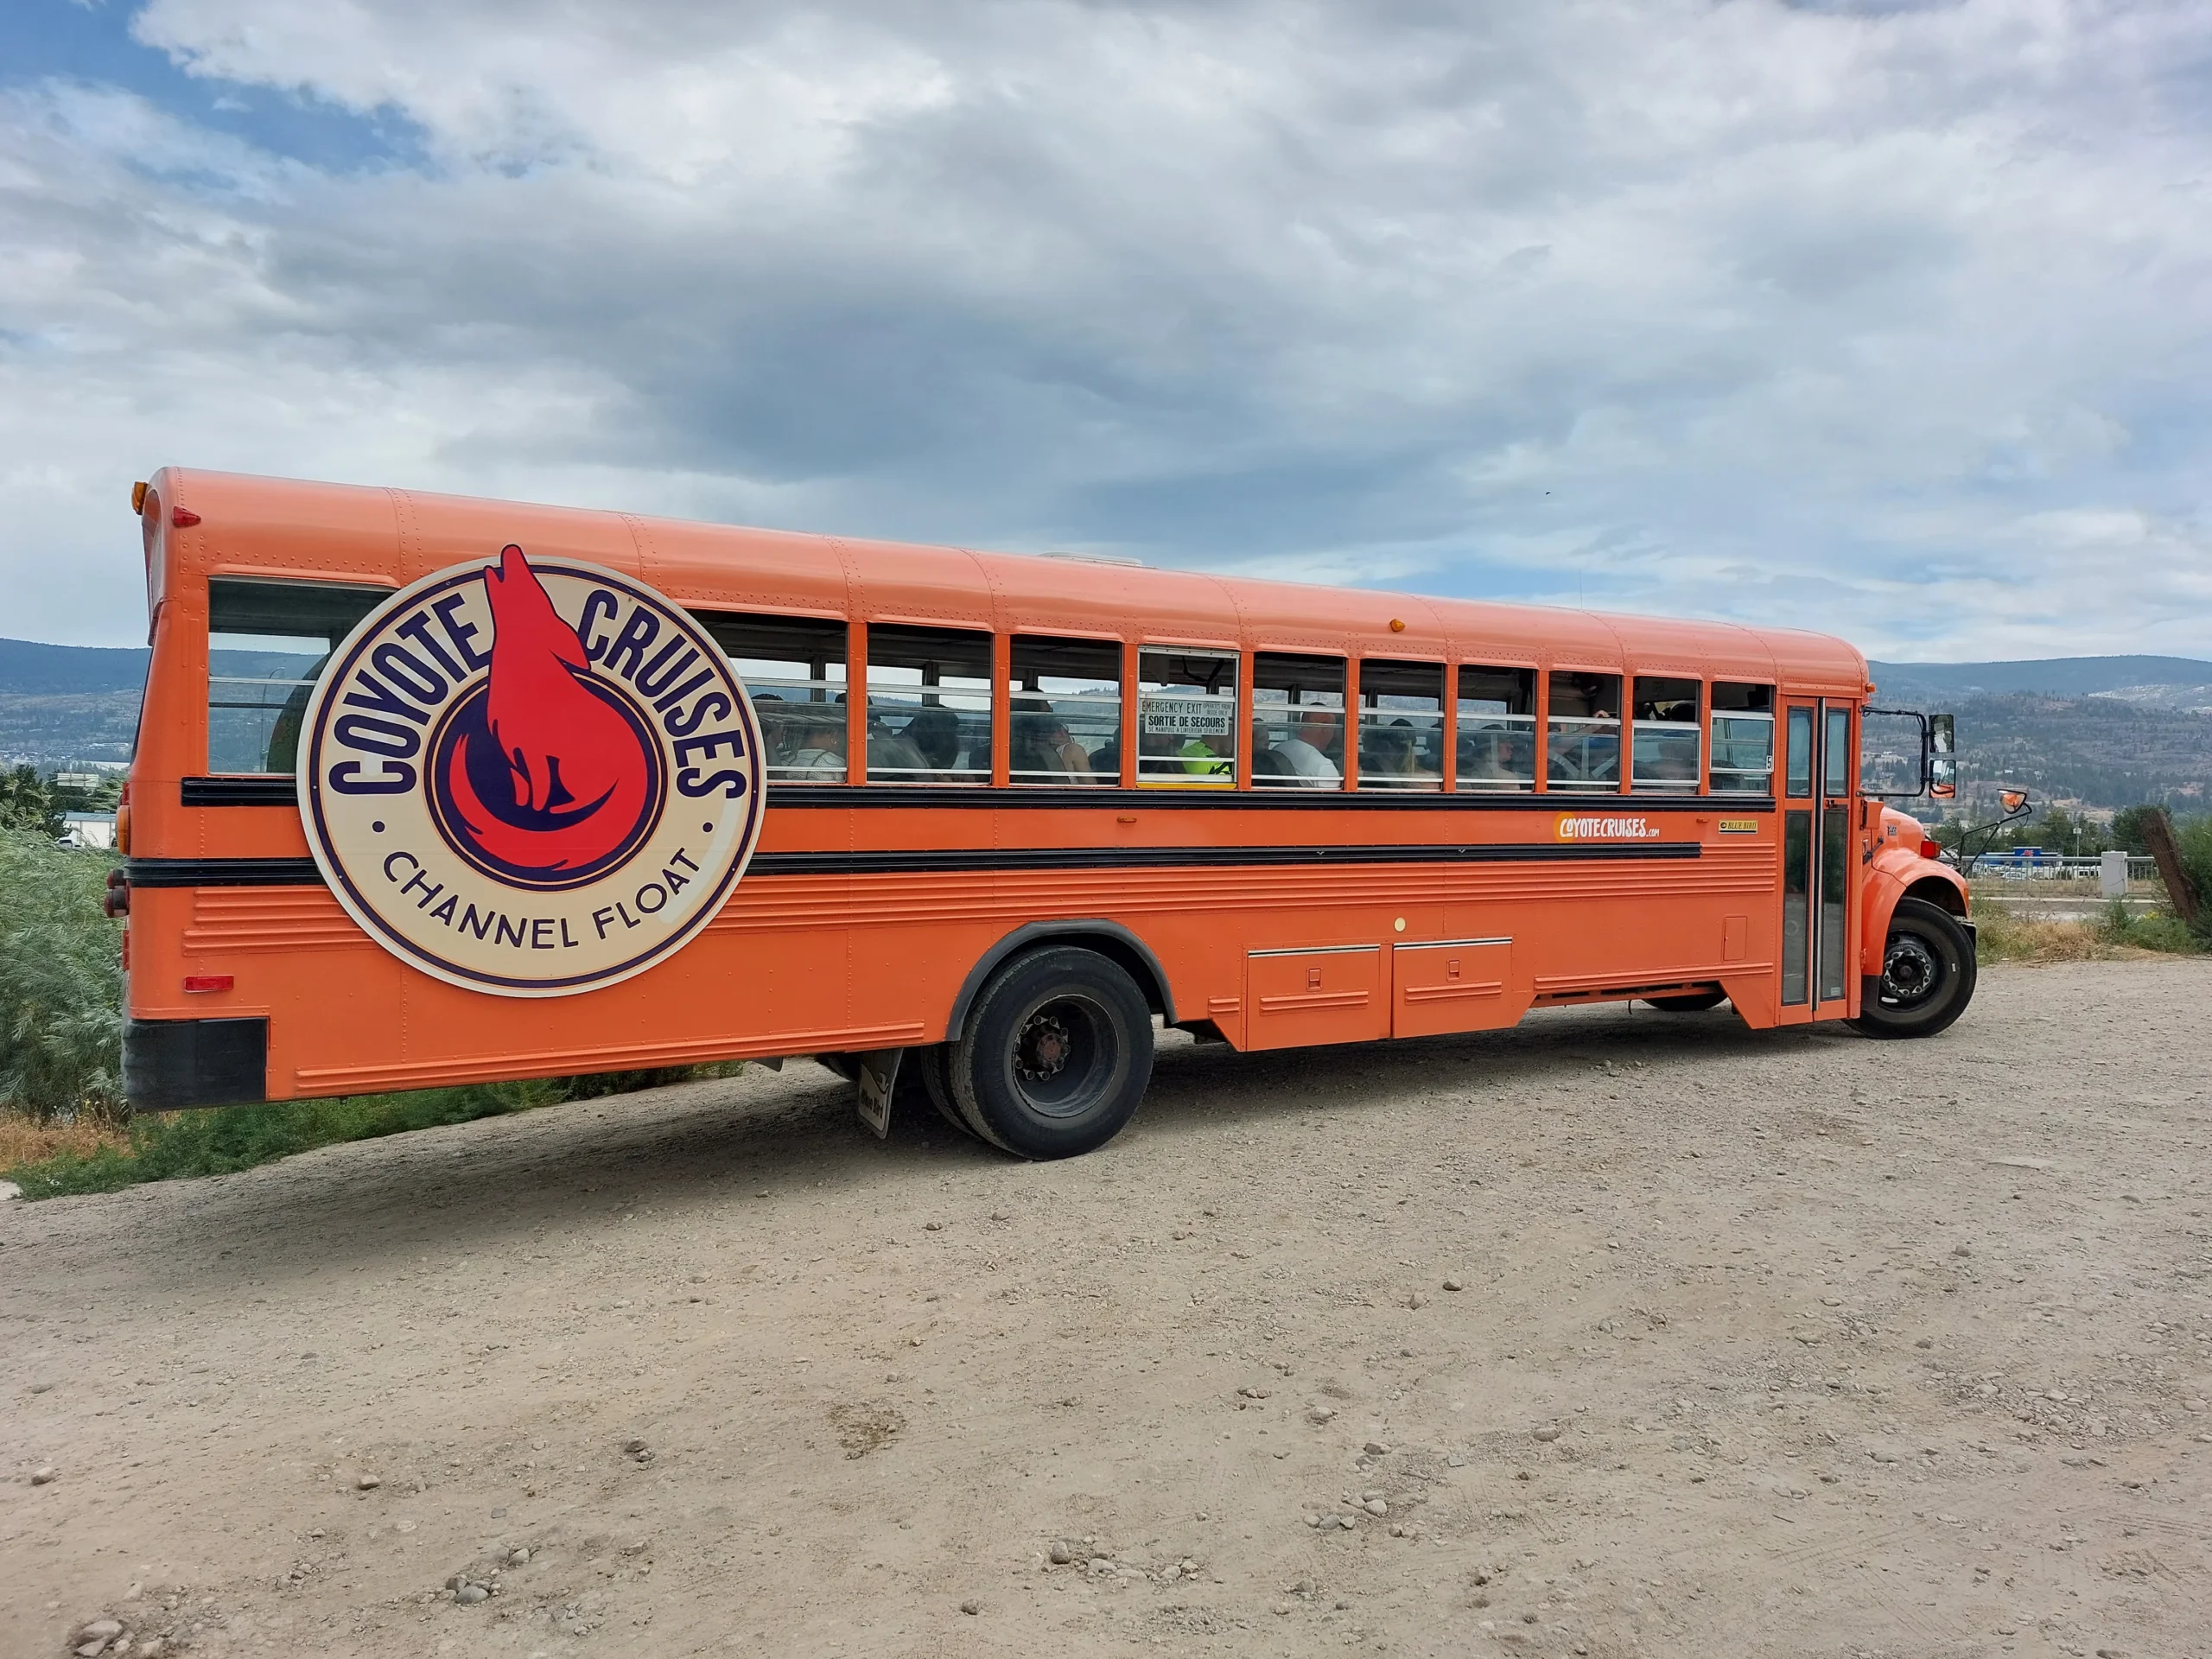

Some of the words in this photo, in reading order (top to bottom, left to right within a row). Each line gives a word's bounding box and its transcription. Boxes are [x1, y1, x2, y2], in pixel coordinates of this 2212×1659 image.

[328, 593, 491, 795] COYOTE
[578, 589, 747, 800] CRUISES
[1141, 701, 1184, 714] EMERGENCY
[1186, 702, 1202, 715] EXIT
[1148, 715, 1176, 727] SORTIE
[1179, 715, 1189, 727] DE
[1191, 716, 1225, 728] SECOURS
[1767, 756, 1771, 769] 5
[383, 851, 579, 950] CHANNEL
[591, 848, 700, 940] FLOAT
